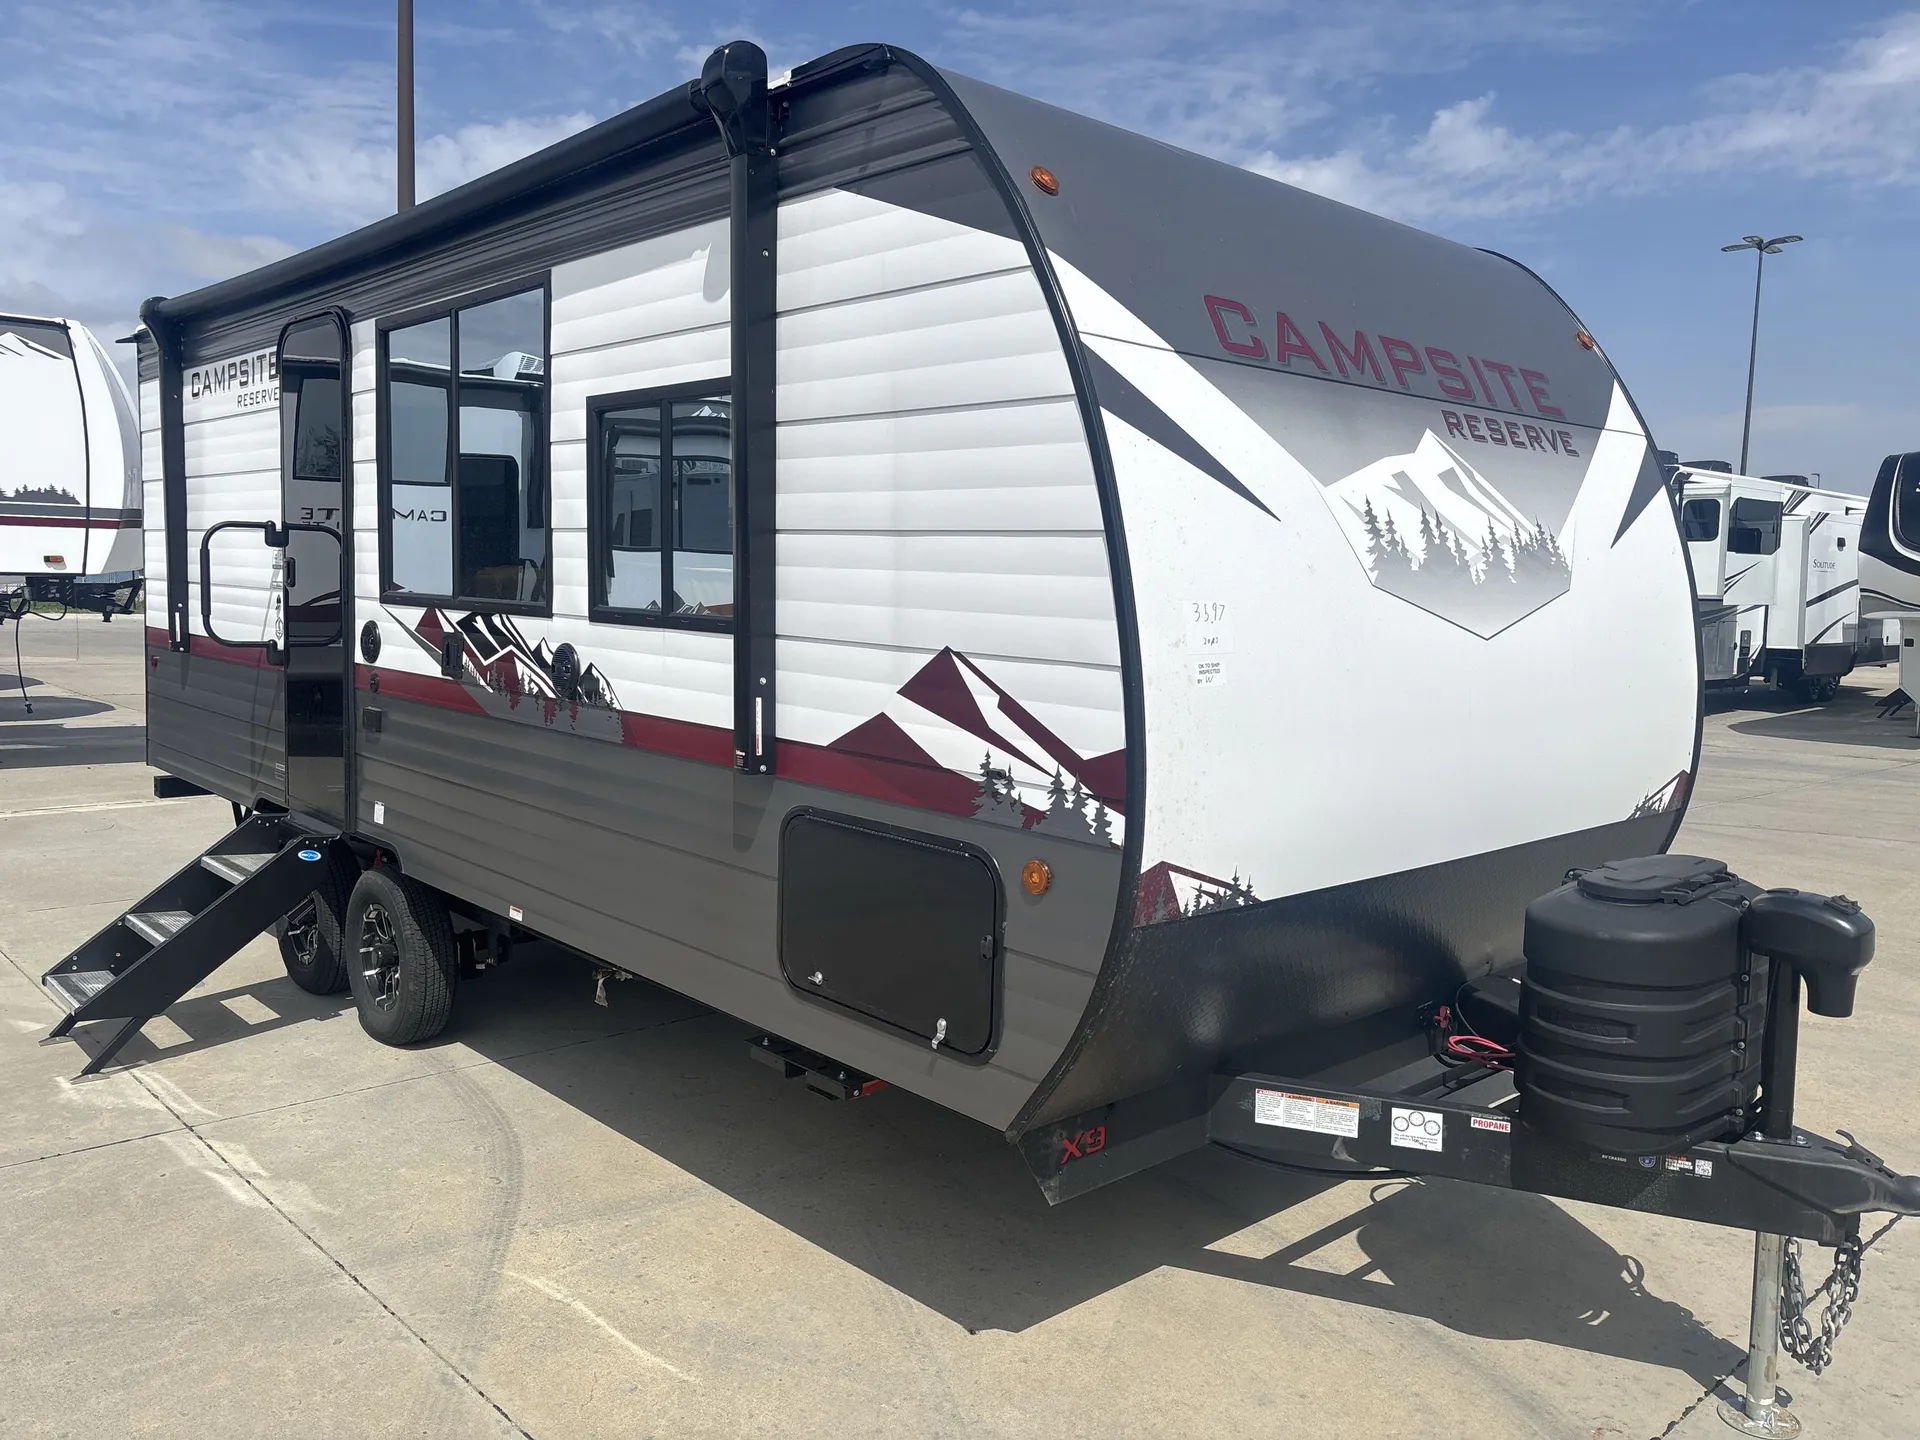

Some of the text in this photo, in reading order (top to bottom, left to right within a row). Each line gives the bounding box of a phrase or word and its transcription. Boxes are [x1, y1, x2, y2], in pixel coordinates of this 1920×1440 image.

[191, 351, 279, 400] CAMPSITE
[1203, 294, 1567, 419] CAMPSITE
[237, 387, 280, 408] RESERVE
[1441, 409, 1580, 458] RESERVE
[1060, 1125, 1106, 1165] X9
[1472, 1119, 1510, 1131] PROPANE
